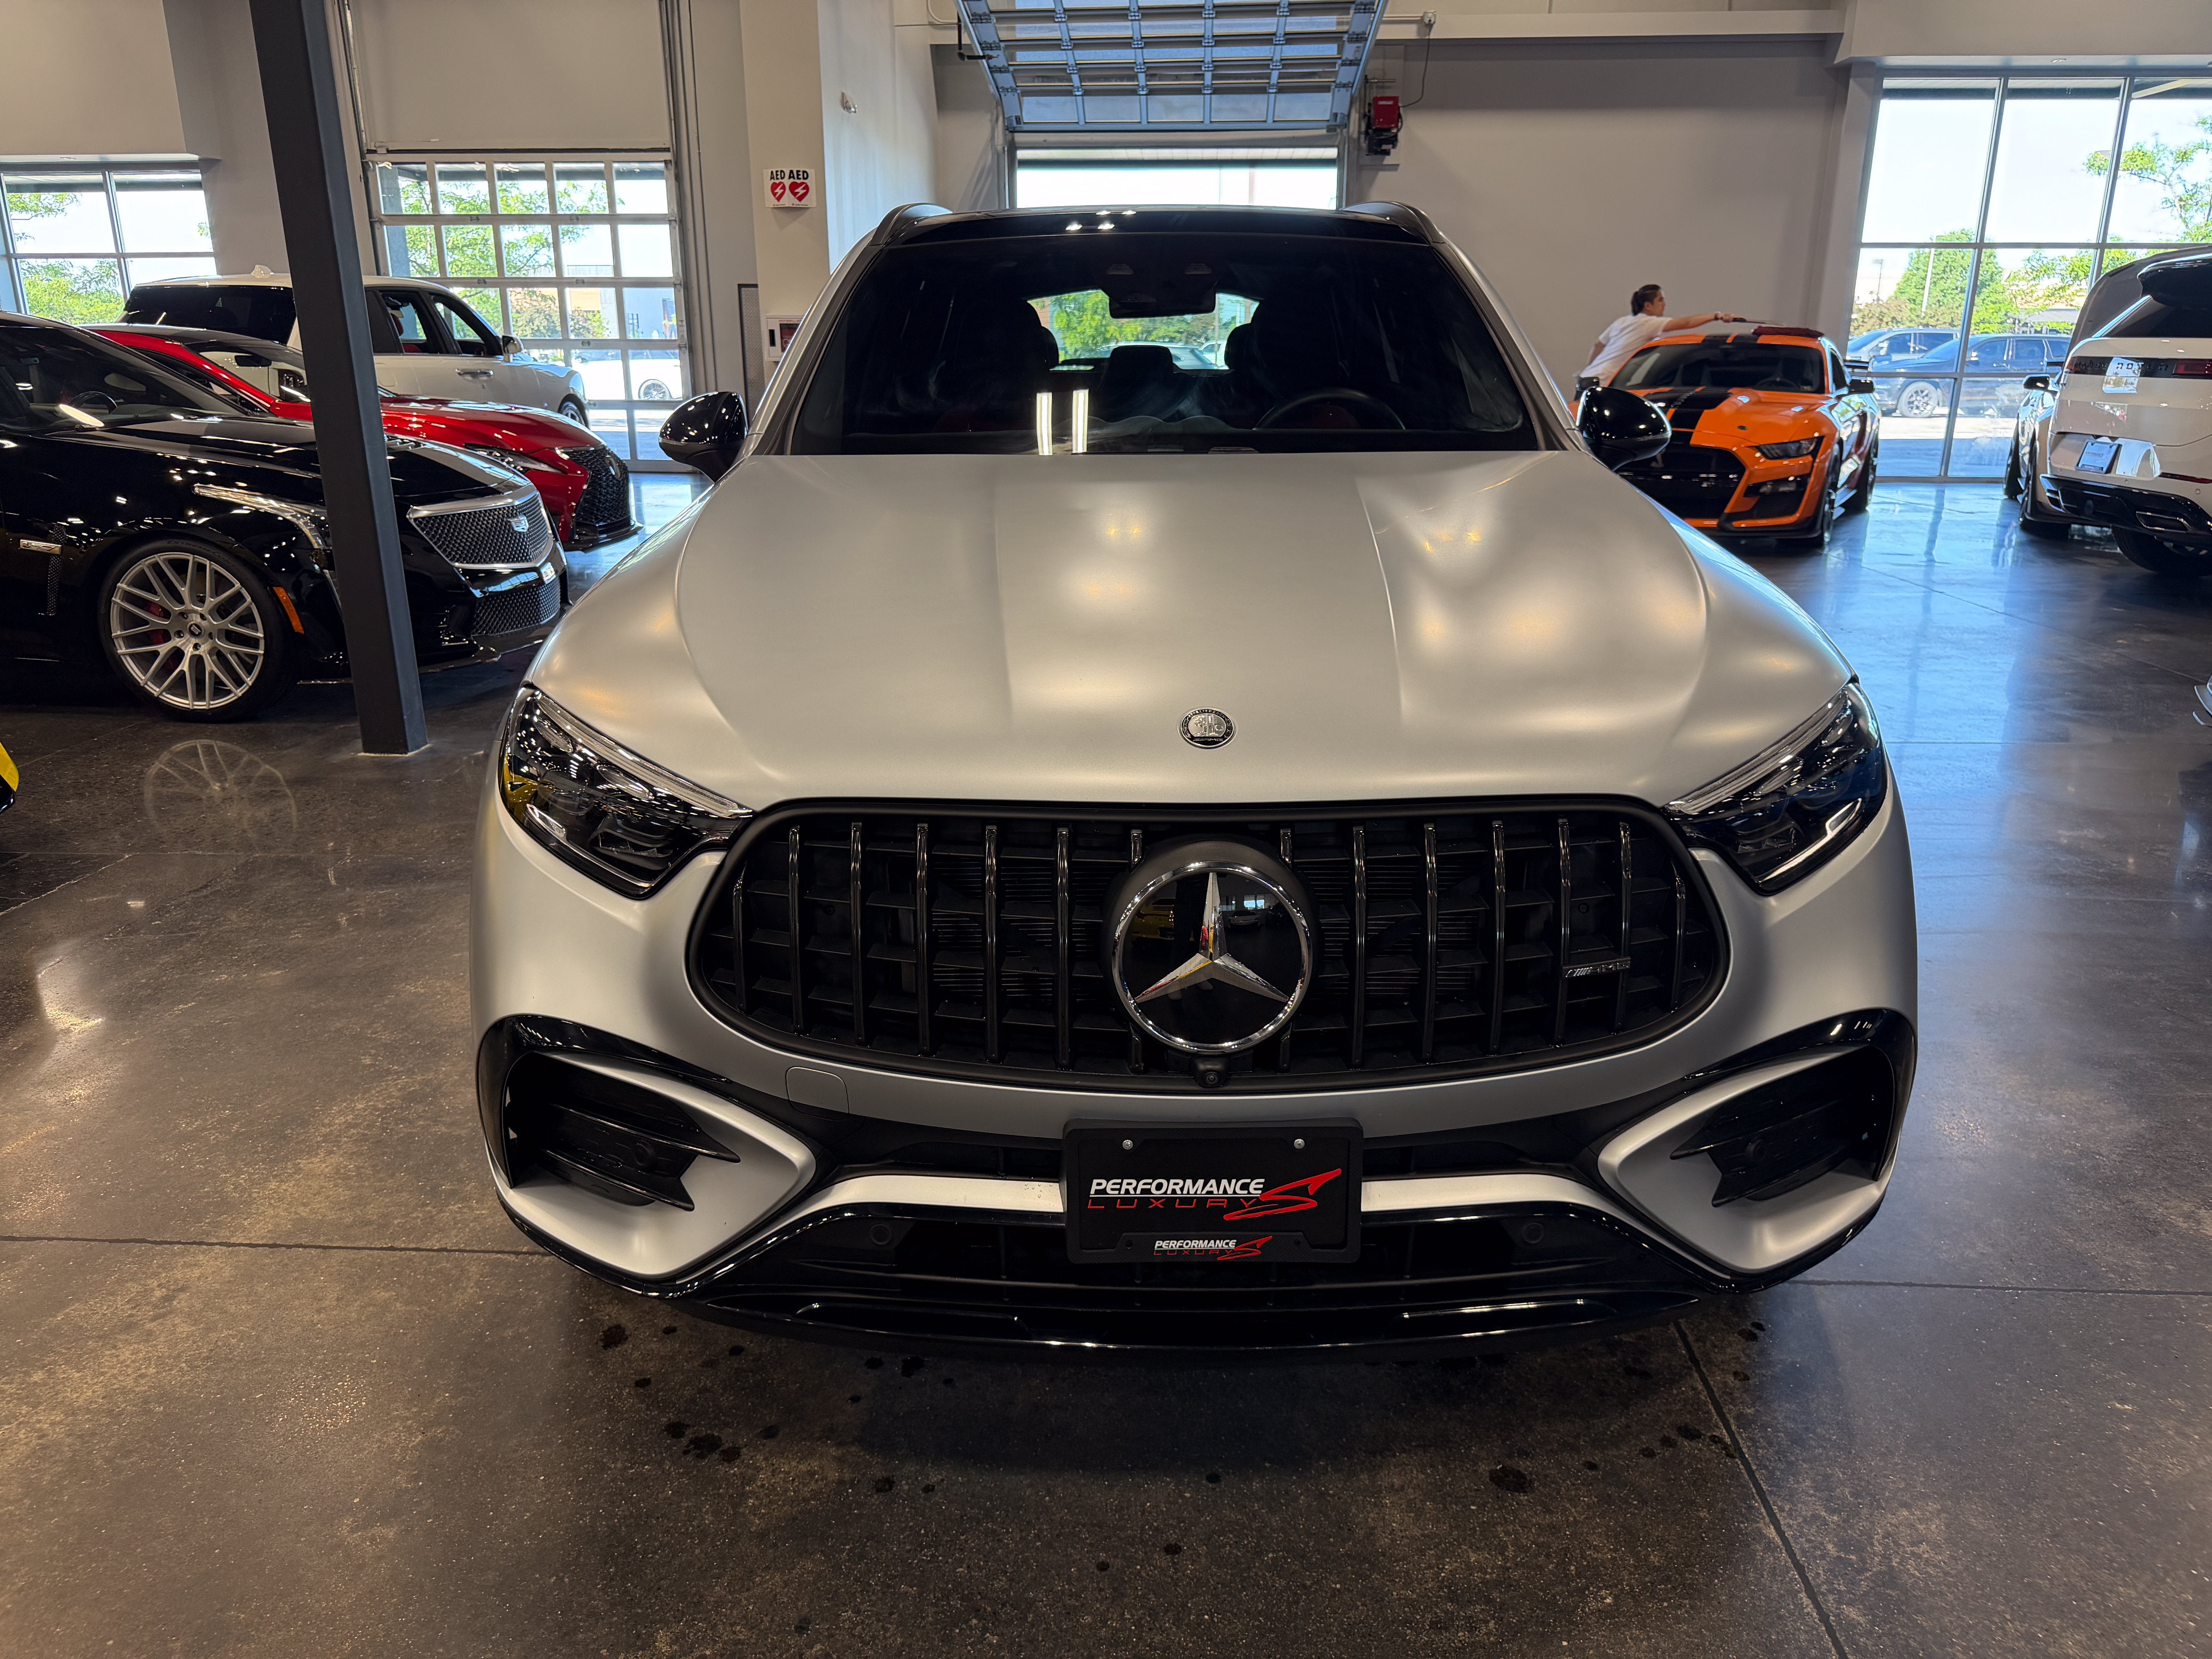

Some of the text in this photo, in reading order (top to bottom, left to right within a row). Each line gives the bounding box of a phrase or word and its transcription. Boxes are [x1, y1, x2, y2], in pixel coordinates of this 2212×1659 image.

[770, 170, 785, 180] AED
[788, 170, 809, 180] AED
[1090, 1178, 1265, 1194] PERFORMANCE
[1087, 1199, 1257, 1209] LUXURY
[1154, 1240, 1237, 1249] PERFORMANCE
